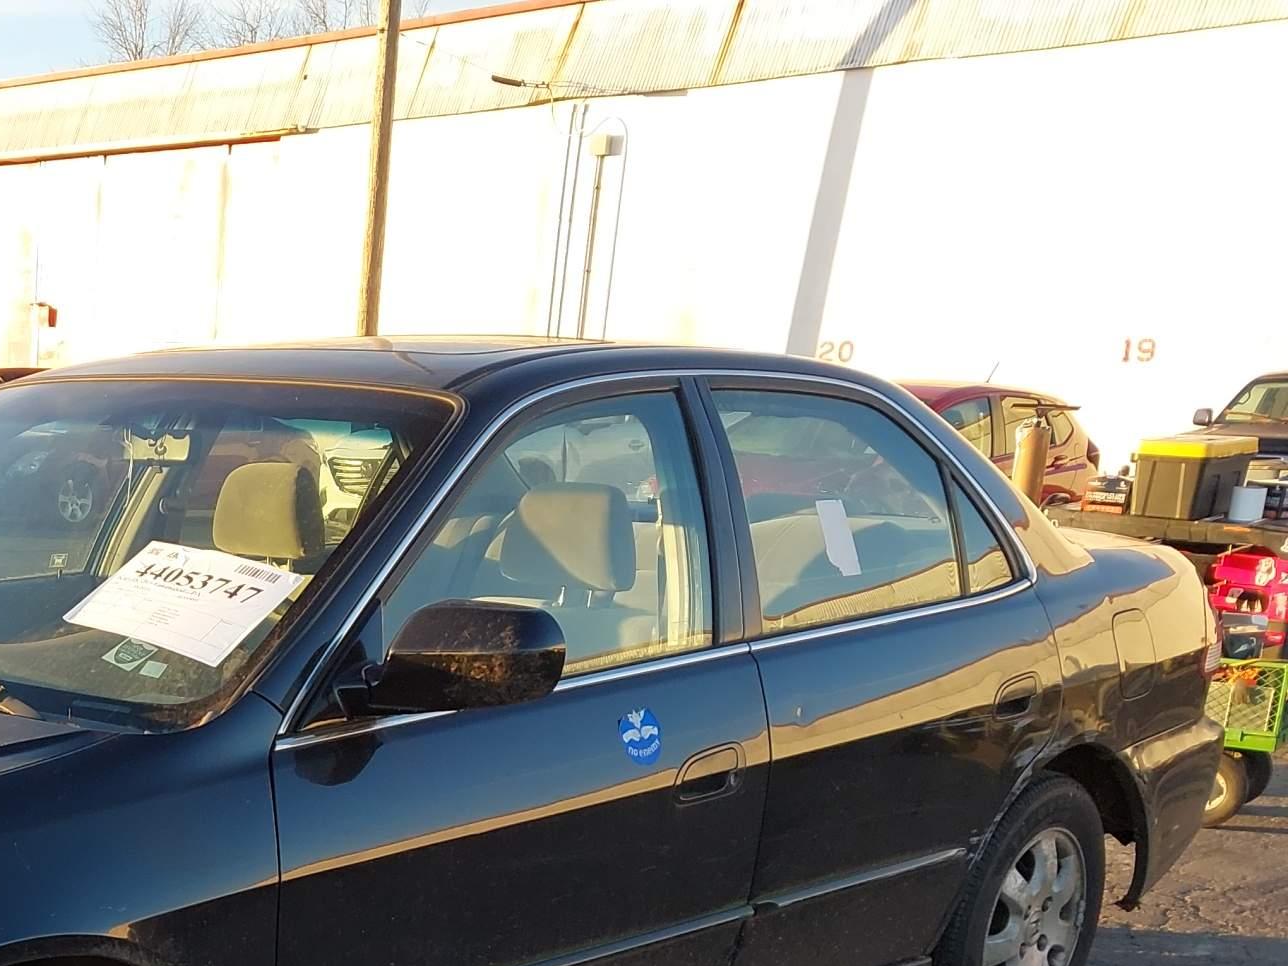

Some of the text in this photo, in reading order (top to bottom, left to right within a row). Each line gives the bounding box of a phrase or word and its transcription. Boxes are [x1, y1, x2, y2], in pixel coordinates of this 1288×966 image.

[819, 340, 854, 362] 20
[1122, 338, 1156, 362] 19
[136, 563, 264, 604] 44053747
